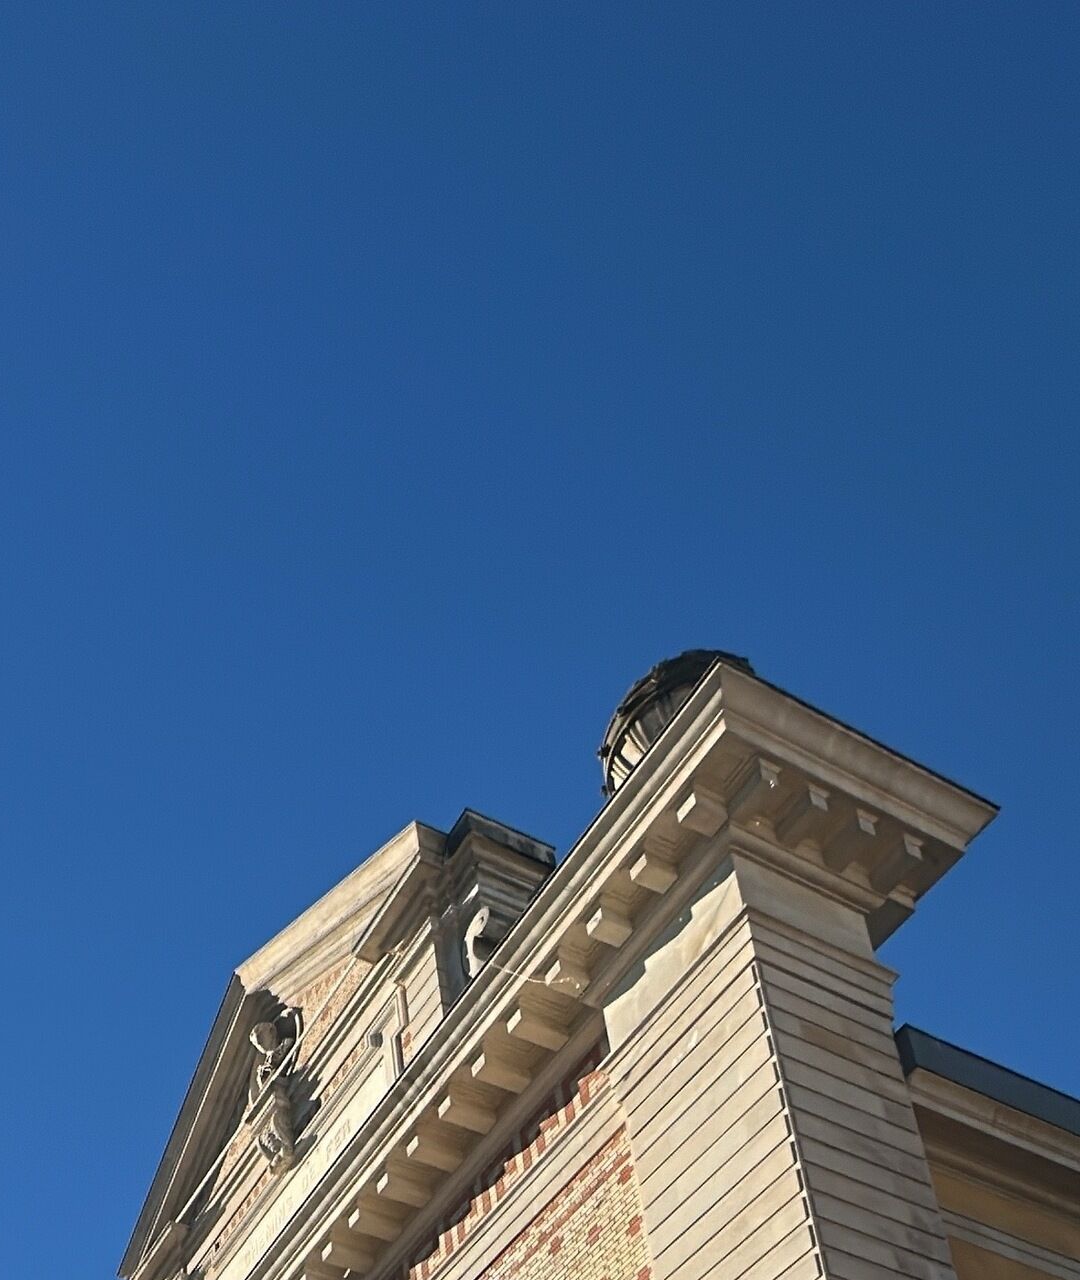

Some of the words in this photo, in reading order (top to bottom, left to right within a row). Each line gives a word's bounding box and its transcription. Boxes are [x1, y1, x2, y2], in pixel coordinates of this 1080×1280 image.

[244, 1196, 295, 1265] CHEMINS
[302, 1166, 320, 1192] DE
[326, 1118, 352, 1162] FER
